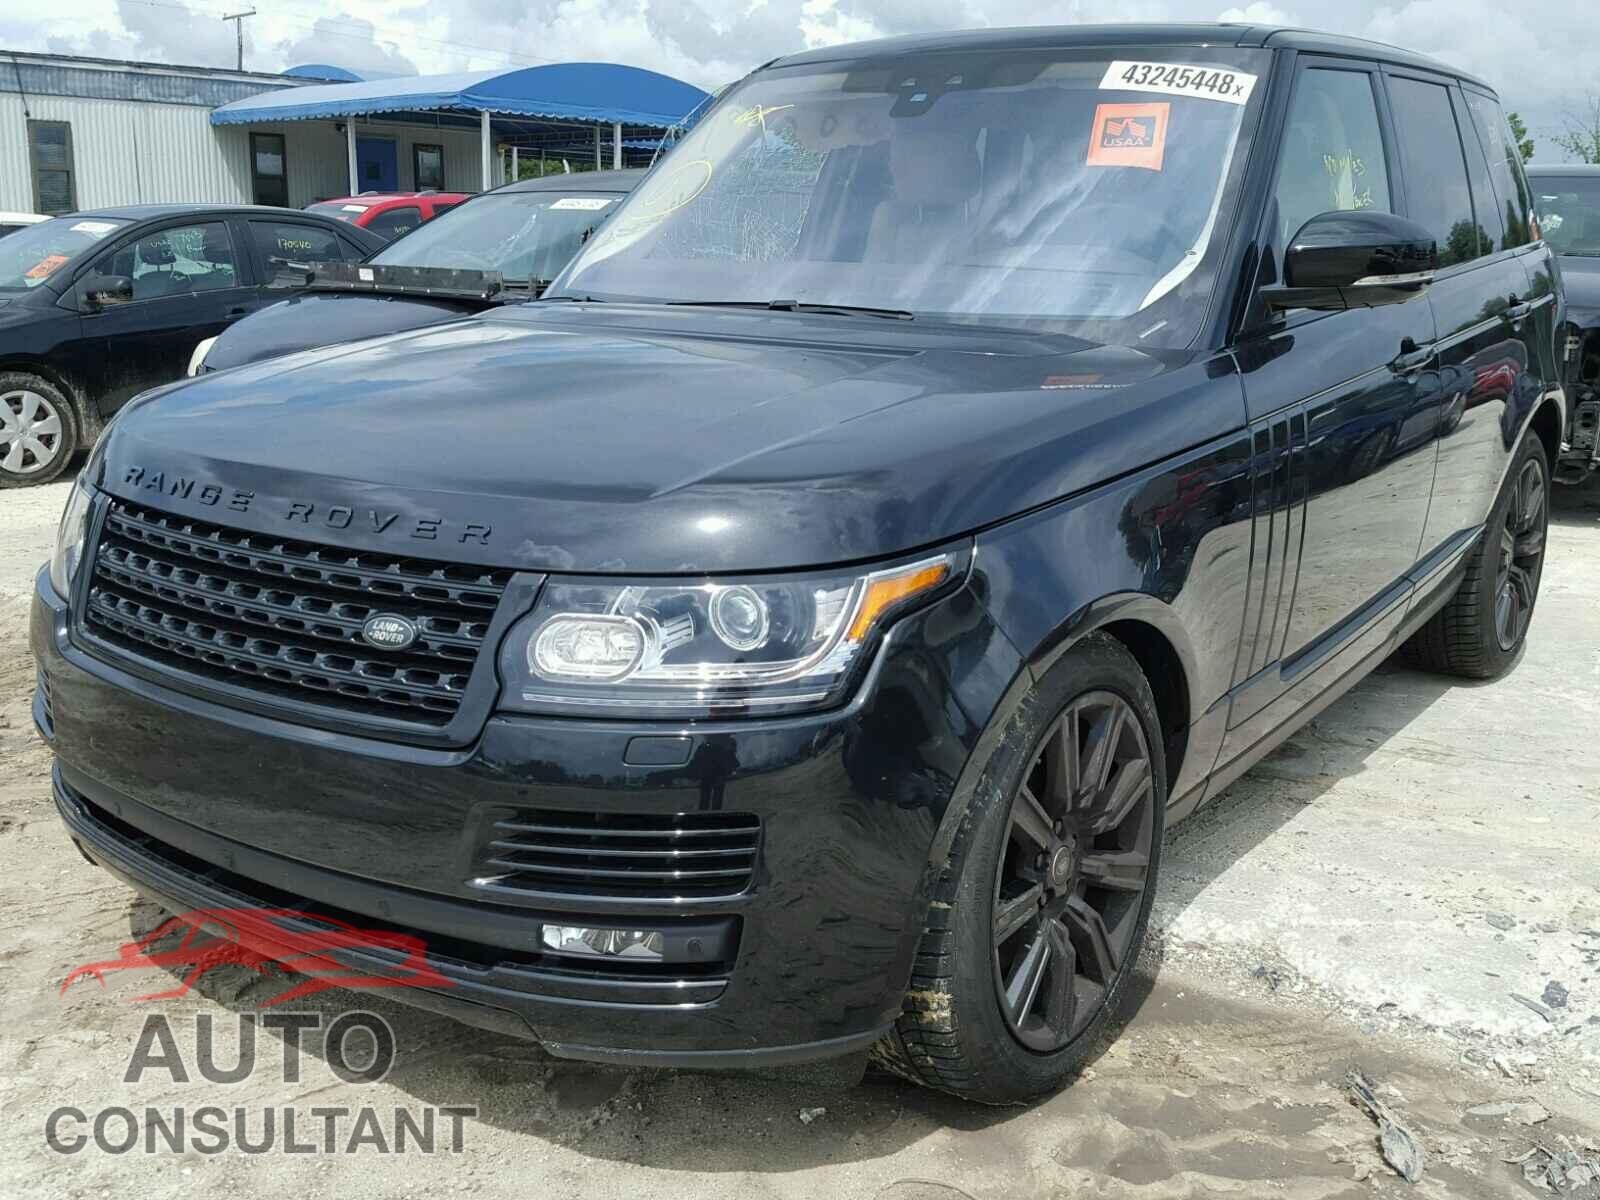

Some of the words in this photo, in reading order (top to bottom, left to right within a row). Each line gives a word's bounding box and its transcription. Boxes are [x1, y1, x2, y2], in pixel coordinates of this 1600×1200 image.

[1103, 136, 1146, 147] USAA
[123, 467, 254, 512] RANGE
[285, 503, 493, 545] ROVER
[372, 630, 404, 643] ROVER
